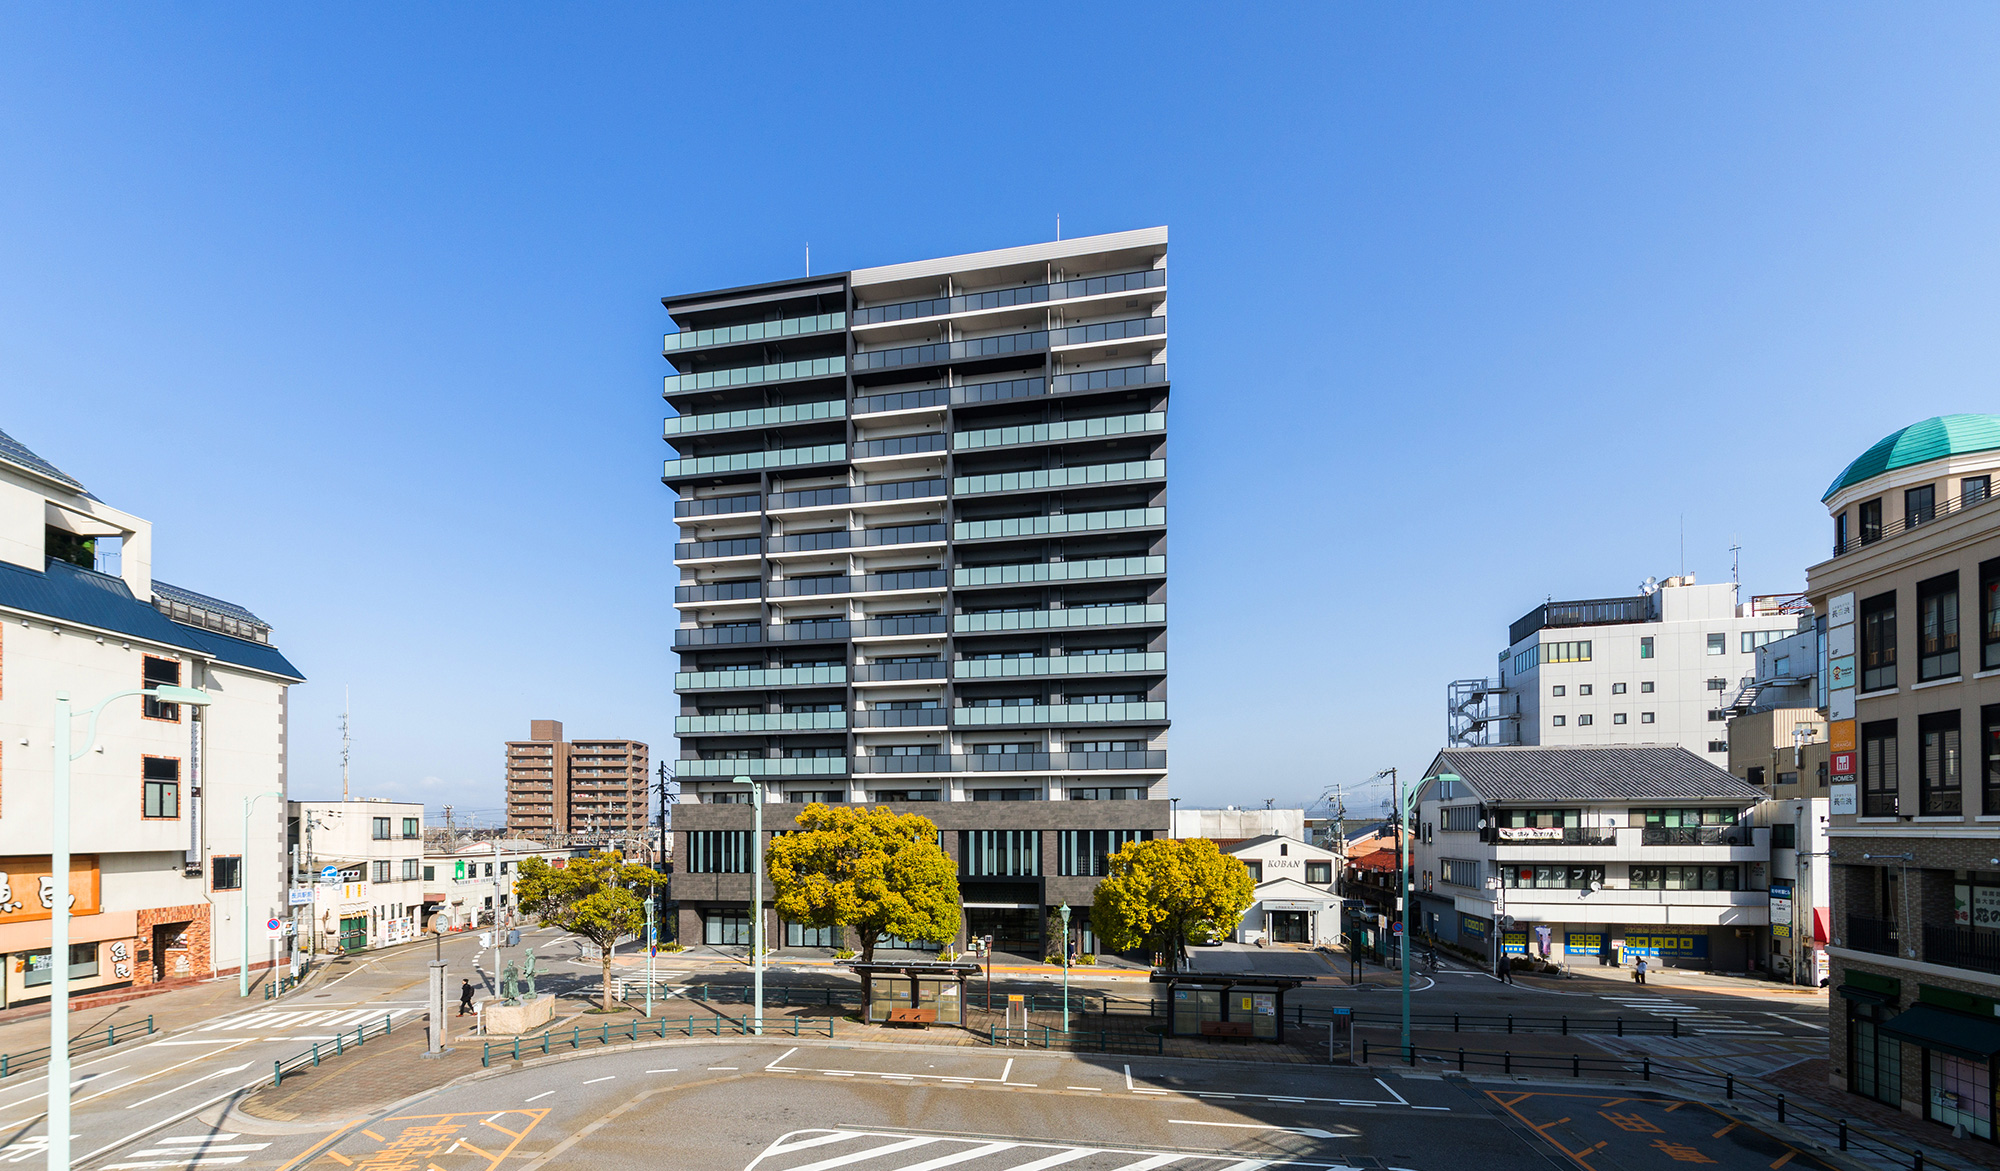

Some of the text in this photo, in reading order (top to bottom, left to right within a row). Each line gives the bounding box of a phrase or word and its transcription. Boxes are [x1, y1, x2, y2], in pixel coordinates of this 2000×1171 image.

[1267, 860, 1301, 868] KOBAN
[1538, 869, 1602, 880] アップル
[110, 941, 131, 978] 魚民
